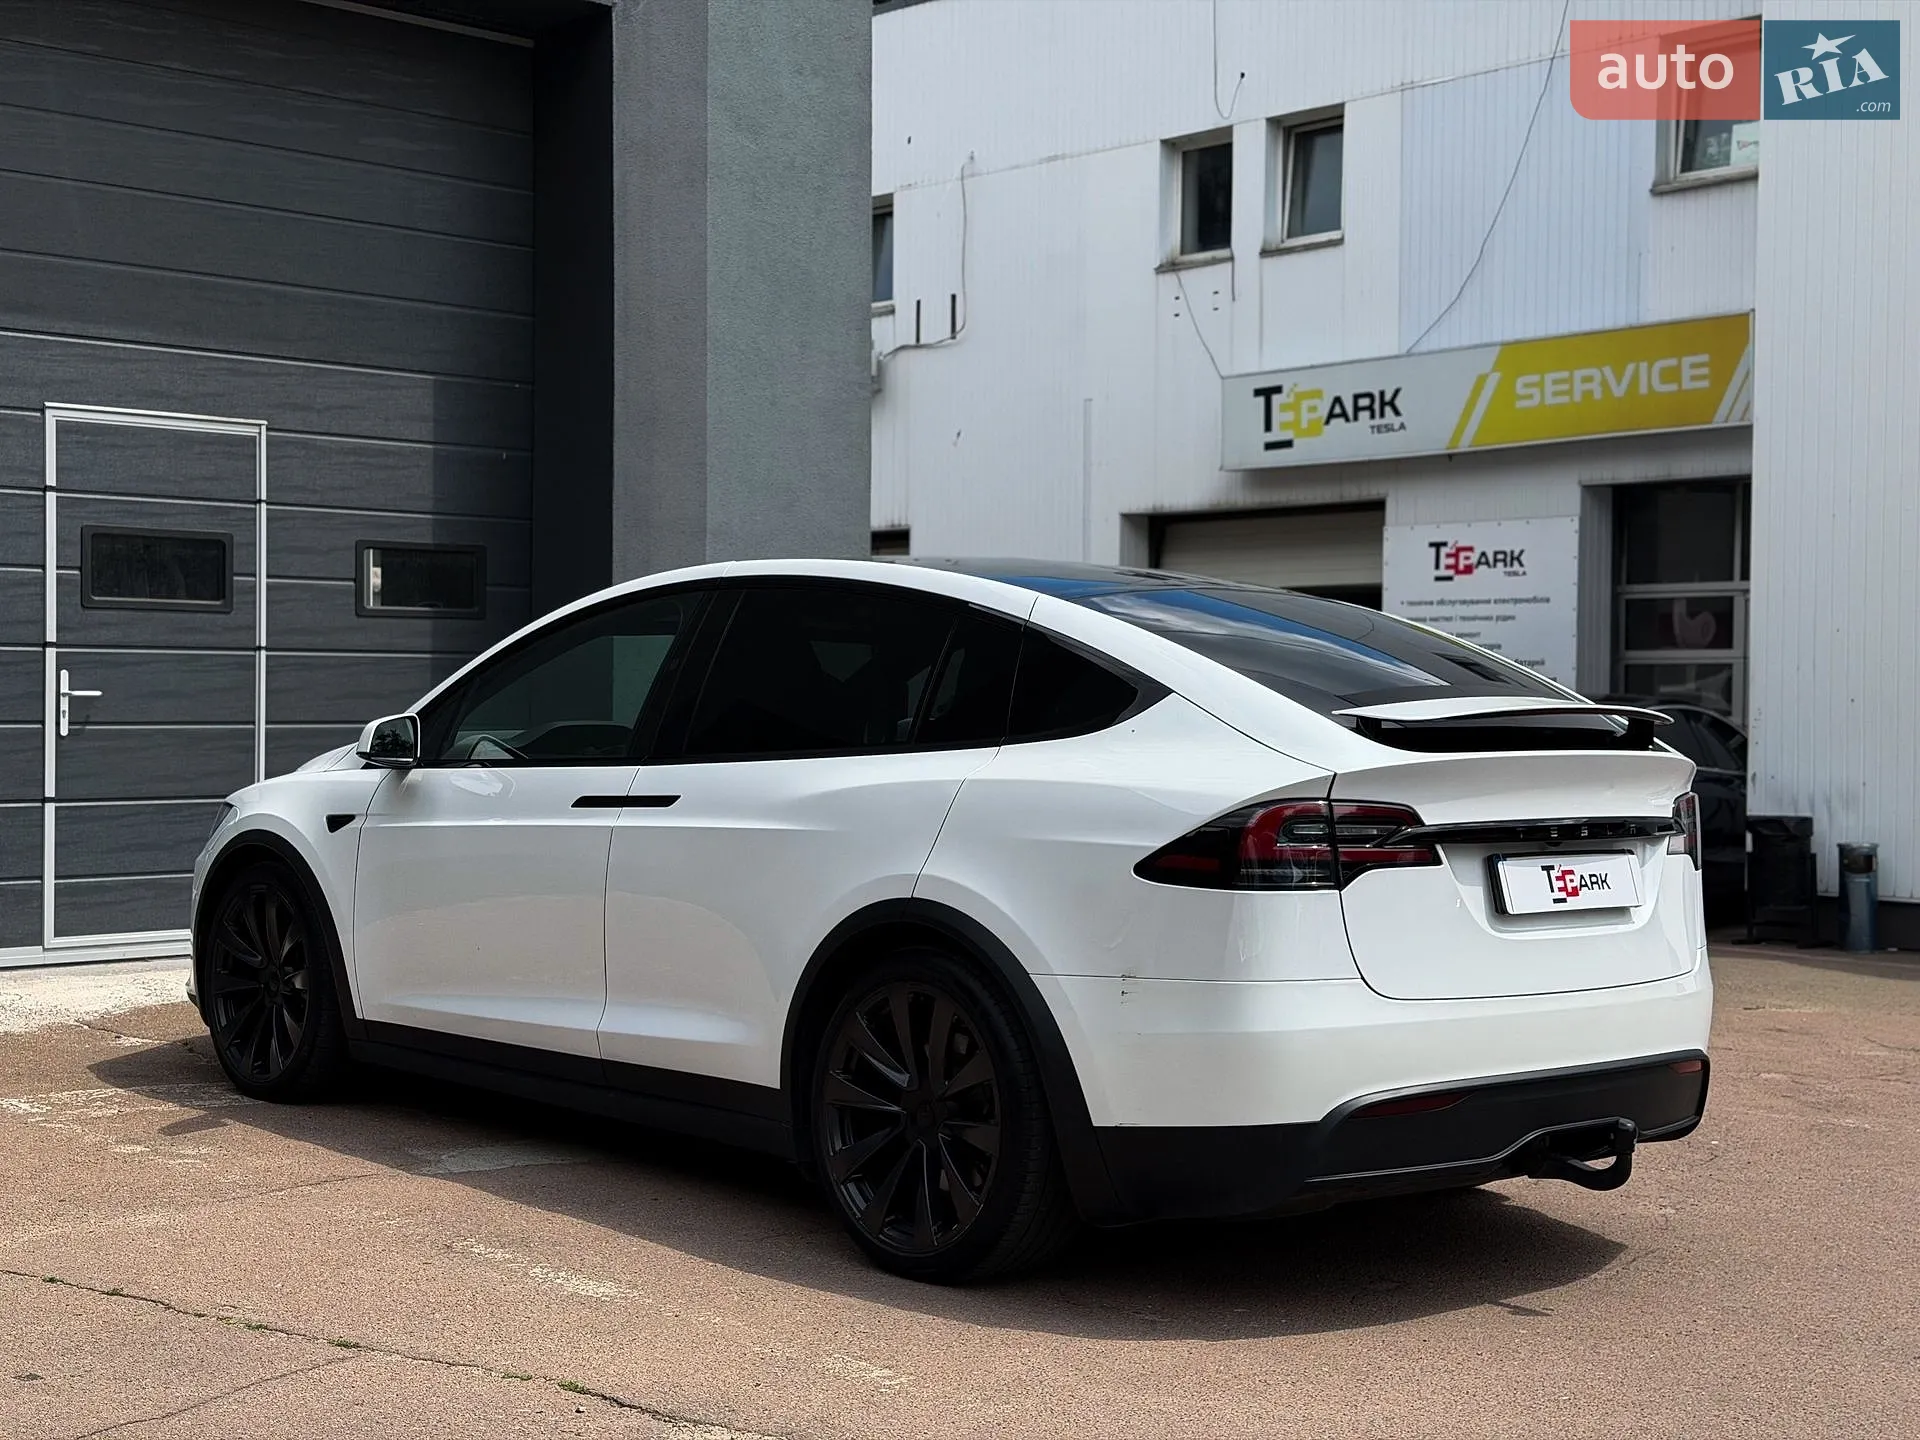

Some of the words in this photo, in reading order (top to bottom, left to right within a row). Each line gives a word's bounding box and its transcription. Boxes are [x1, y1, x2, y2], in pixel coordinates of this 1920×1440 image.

[1515, 353, 1710, 409] SERVICE
[1369, 421, 1407, 435] TESLA
[1503, 570, 1527, 578] TESLA
